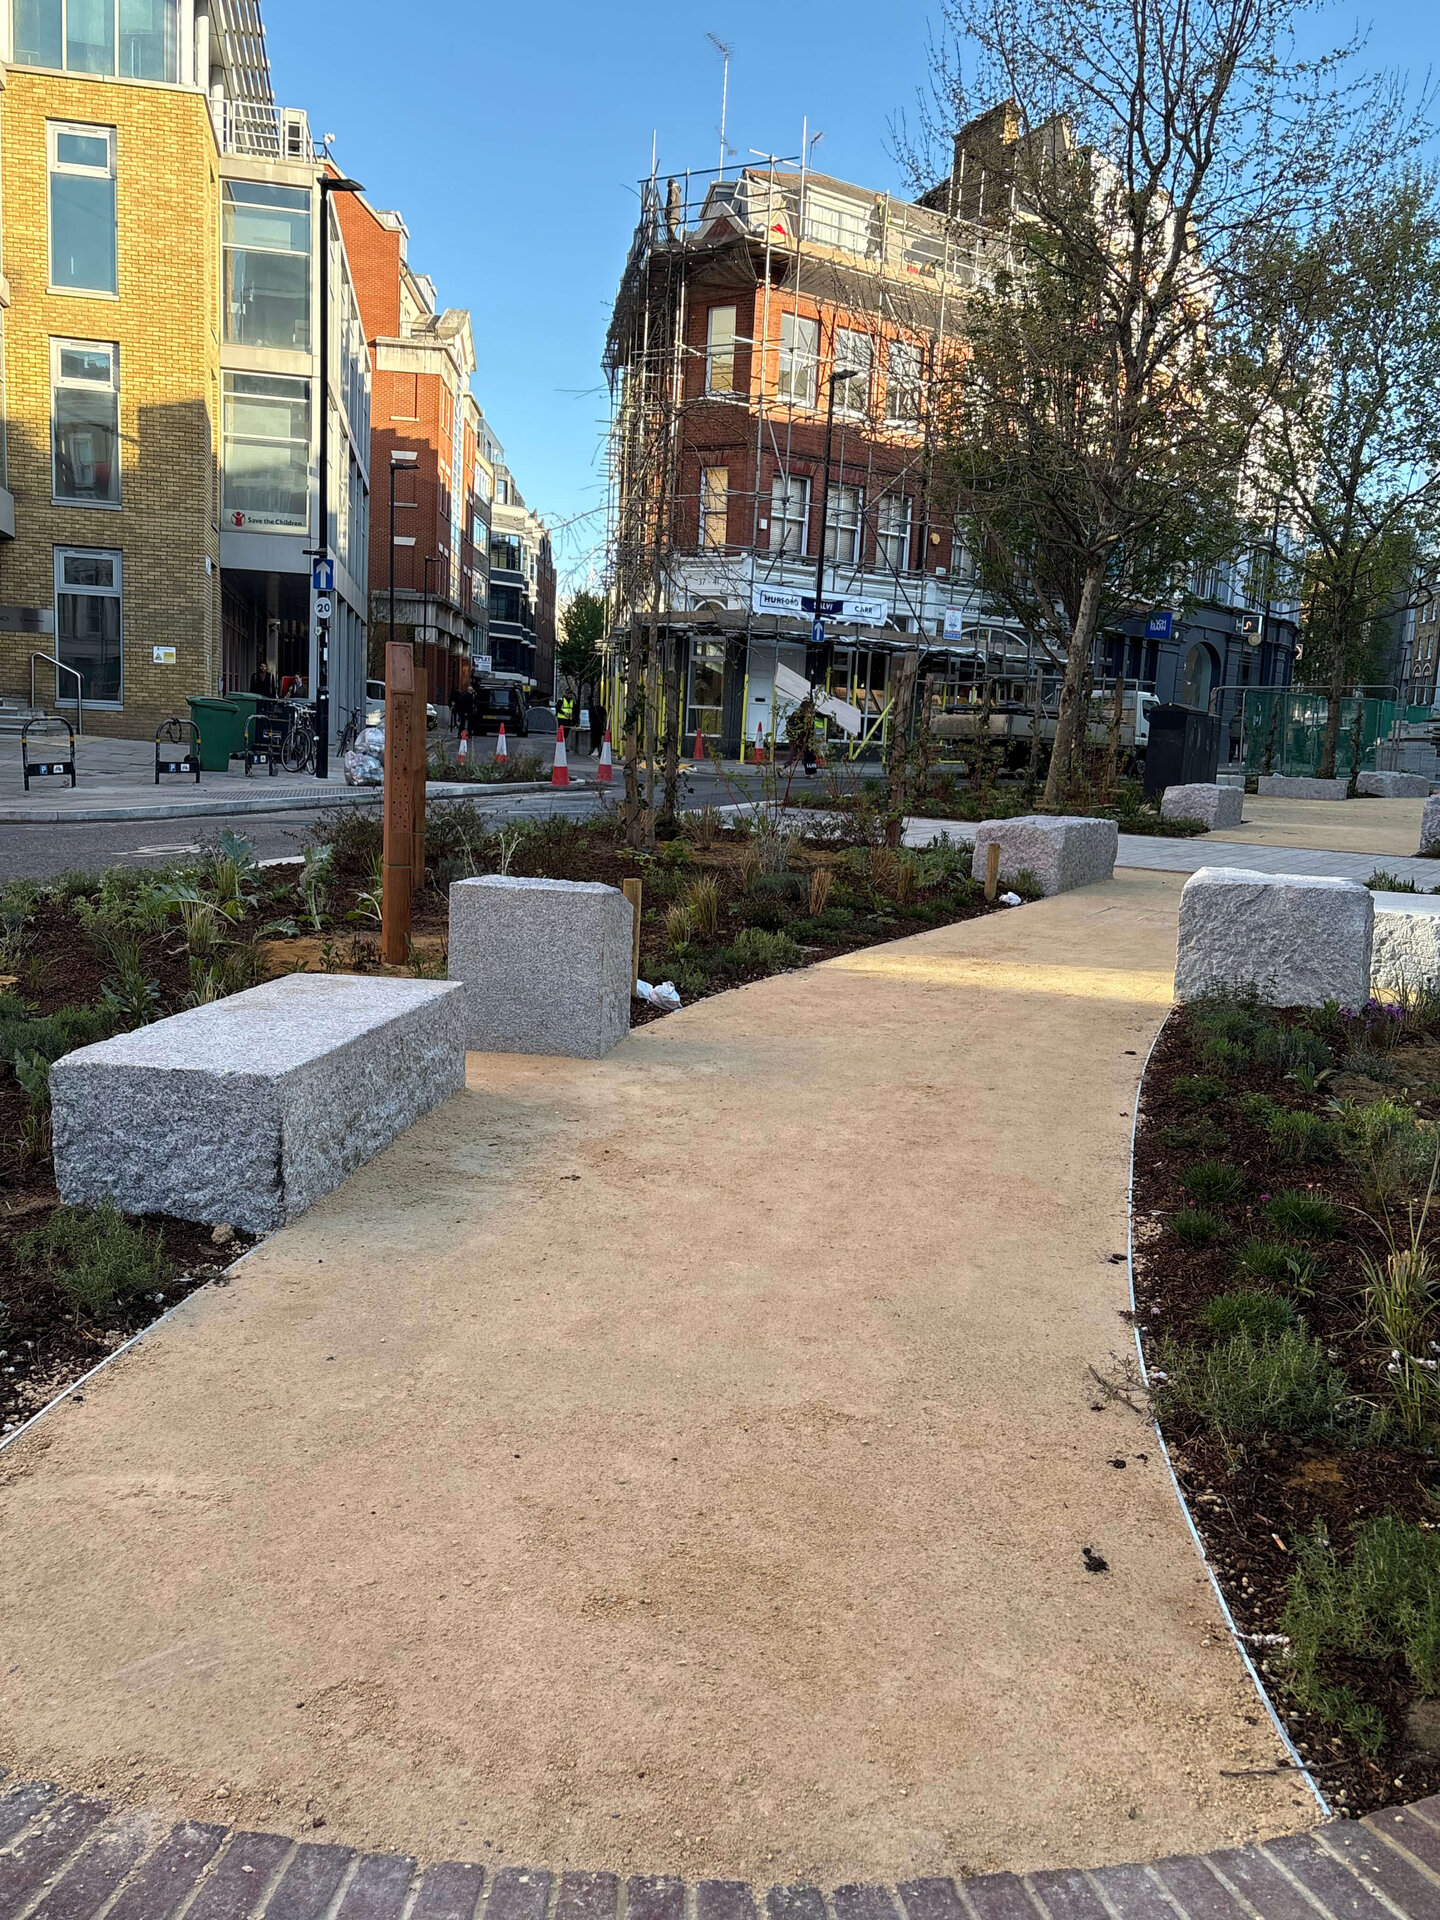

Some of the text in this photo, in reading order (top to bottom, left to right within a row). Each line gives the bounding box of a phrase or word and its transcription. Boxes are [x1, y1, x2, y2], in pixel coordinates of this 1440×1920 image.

[247, 516, 262, 524] Save
[698, 577, 706, 586] 37
[317, 603, 330, 612] 20
[854, 605, 873, 615] CARR
